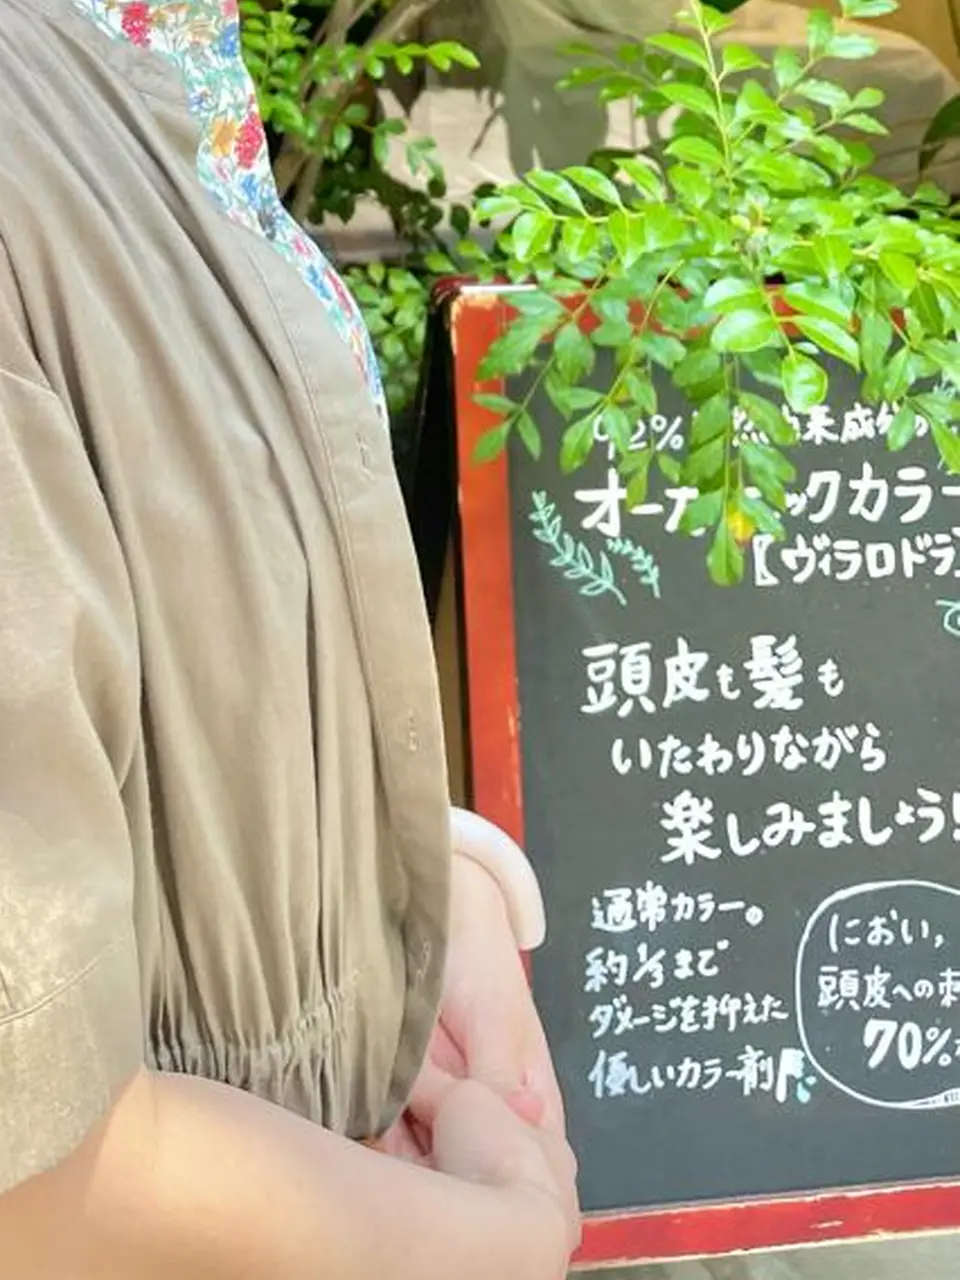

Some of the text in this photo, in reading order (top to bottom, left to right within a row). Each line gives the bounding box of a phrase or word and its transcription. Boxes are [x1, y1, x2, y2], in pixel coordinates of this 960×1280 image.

[581, 634, 845, 717] 頭皮も髪も
[611, 722, 887, 779] いたわりながら
[591, 880, 764, 932] 通常カラーの
[588, 992, 790, 1039] ダメージを抑えた
